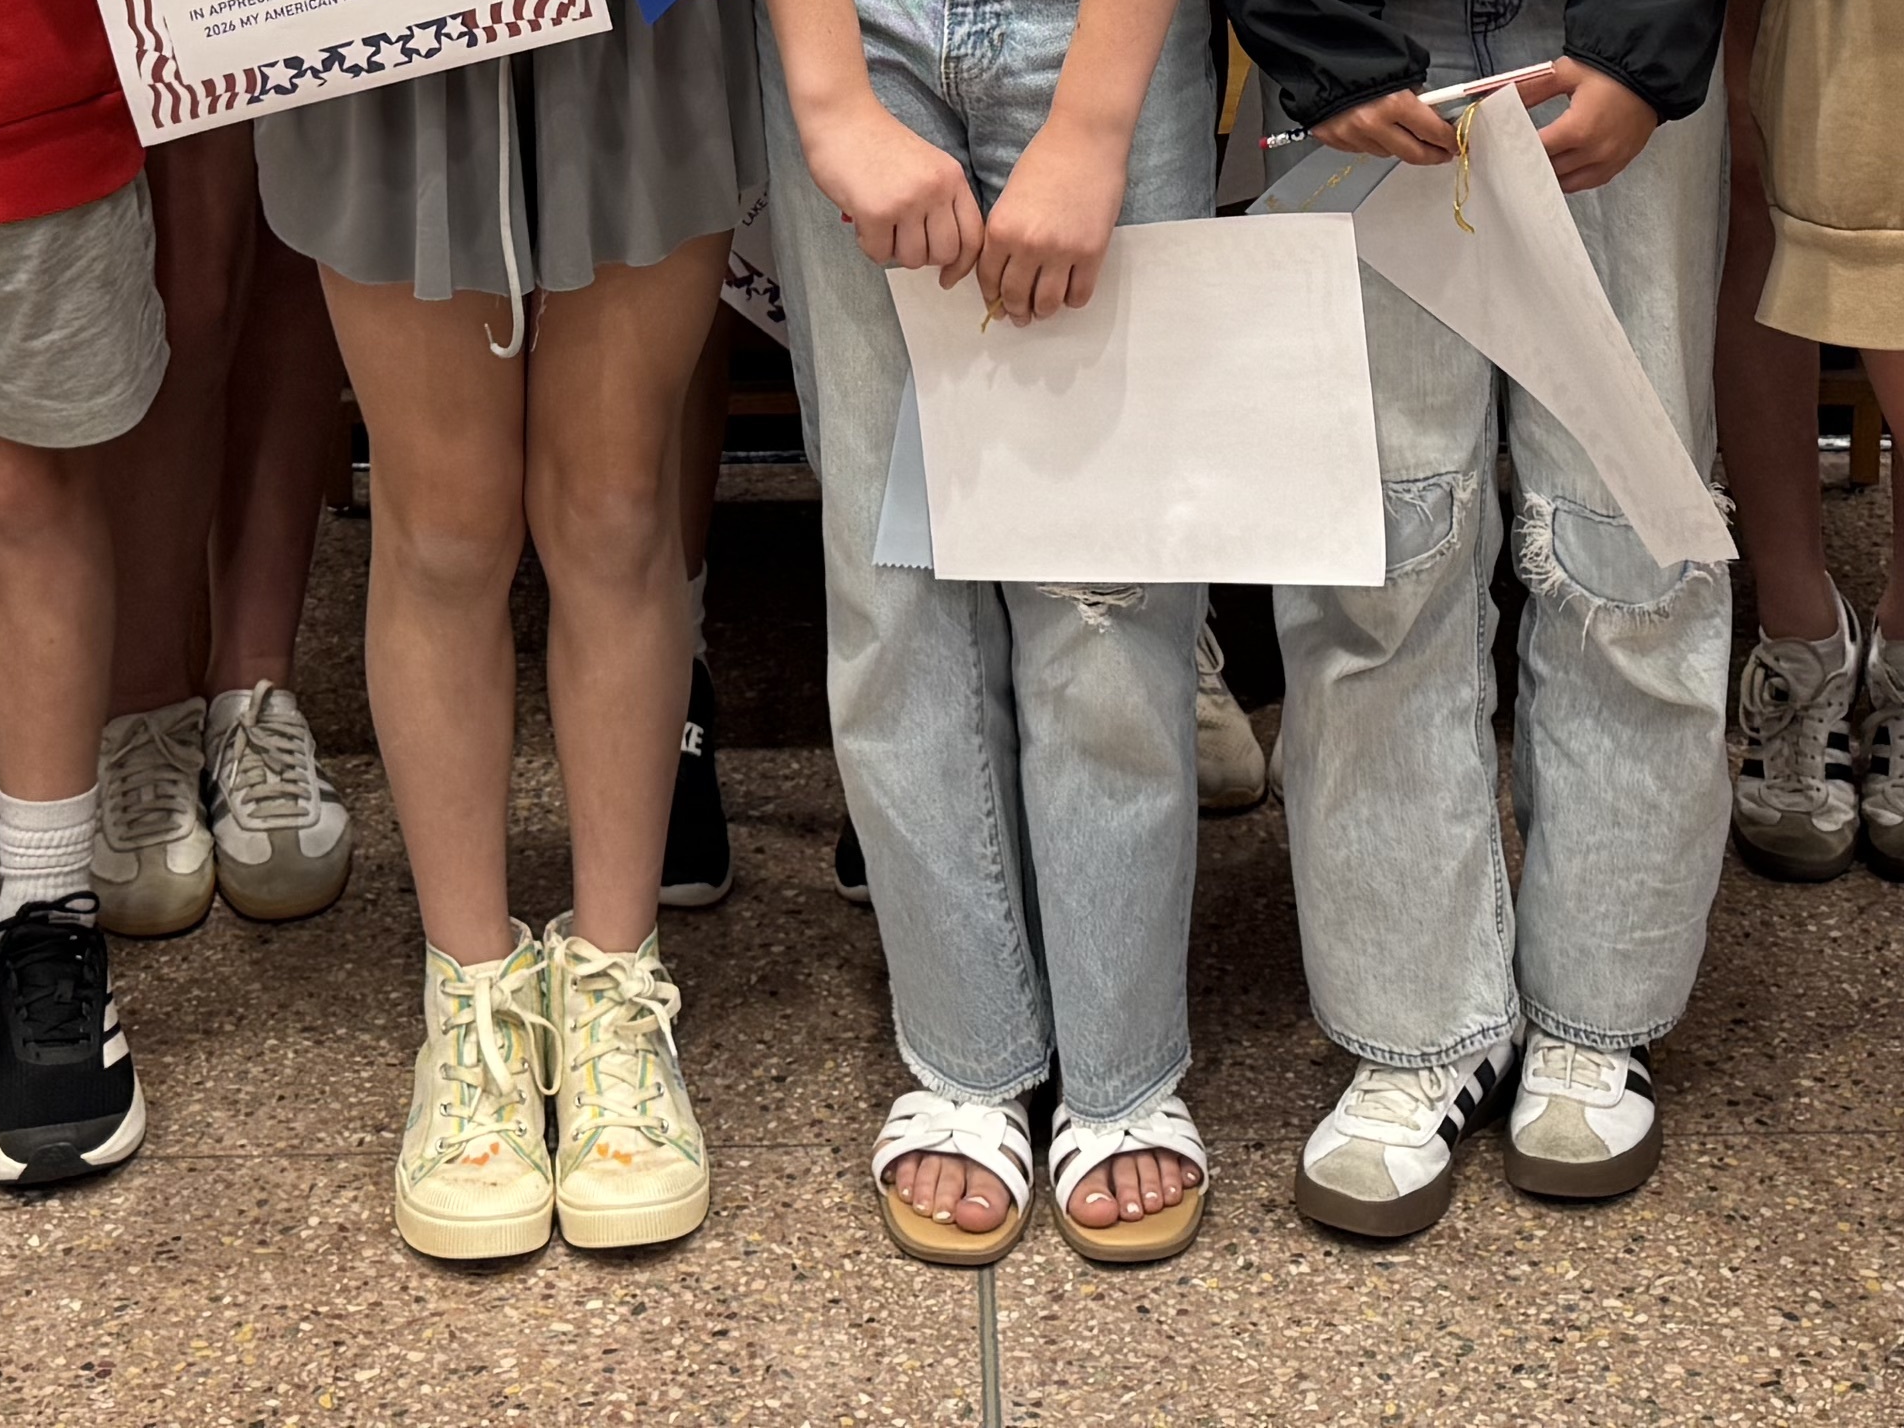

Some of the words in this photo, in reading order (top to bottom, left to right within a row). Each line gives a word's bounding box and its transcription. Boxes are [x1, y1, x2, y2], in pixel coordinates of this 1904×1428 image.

[189, 7, 205, 22] IN
[203, 19, 237, 38] 2026
[239, 12, 259, 28] MY
[742, 198, 769, 227] LAKE
